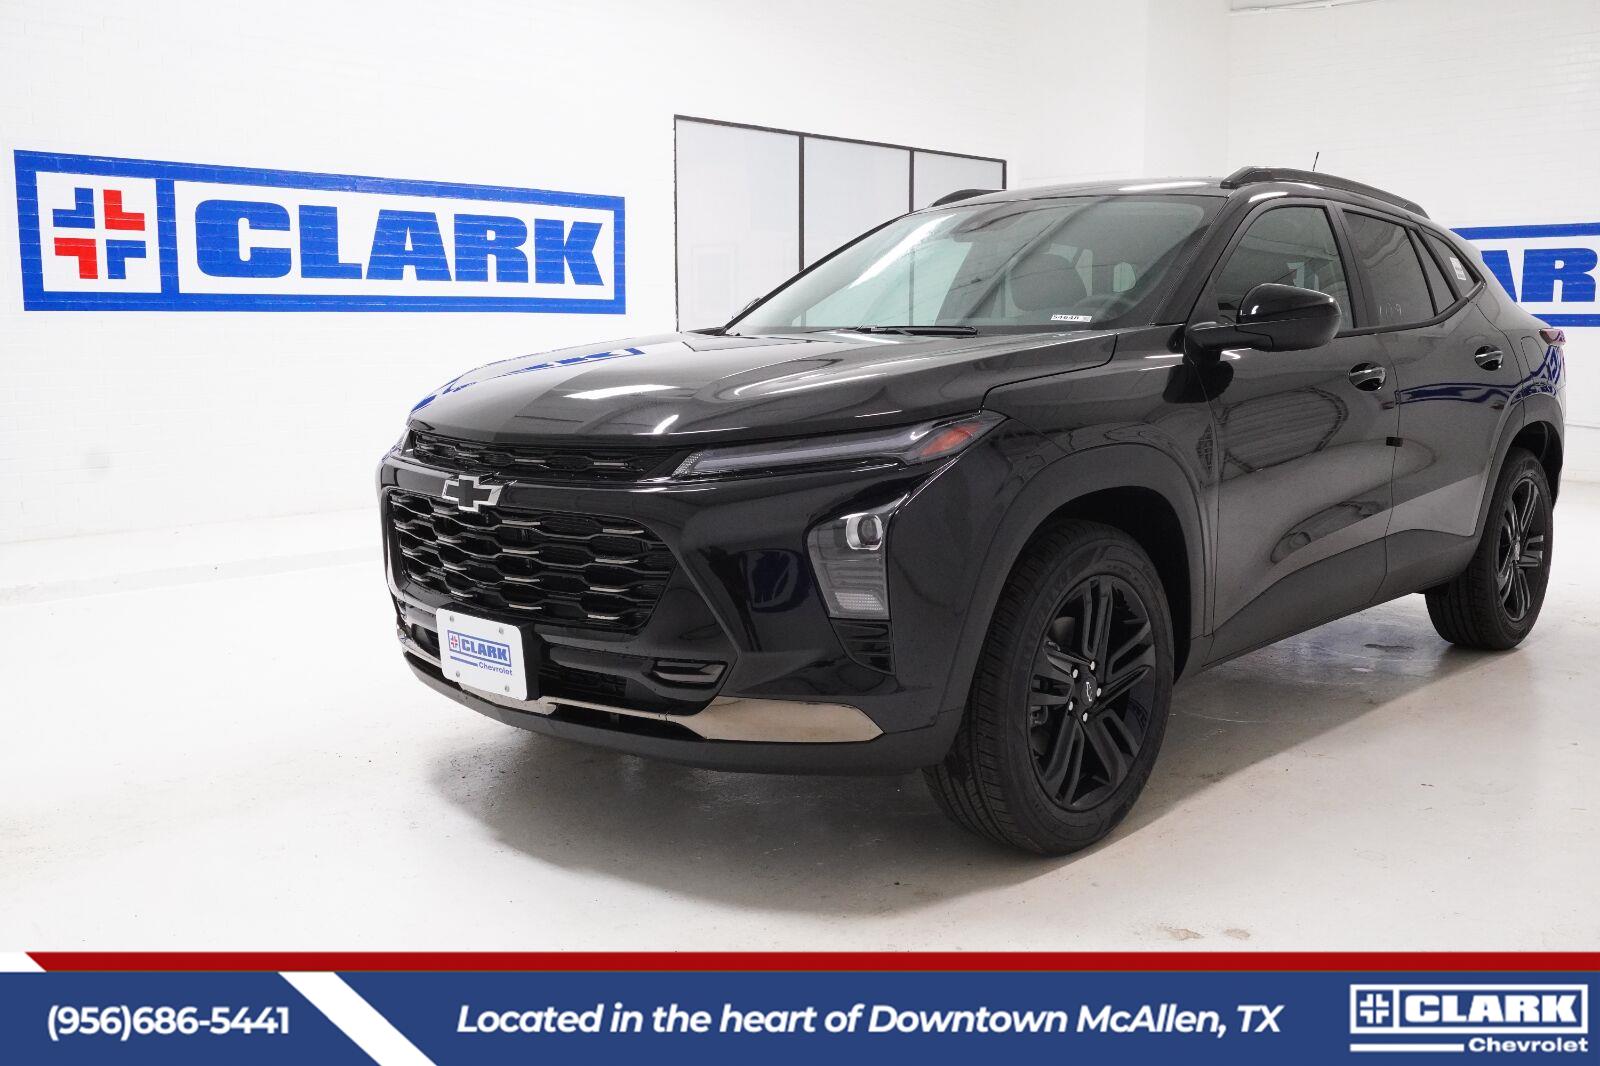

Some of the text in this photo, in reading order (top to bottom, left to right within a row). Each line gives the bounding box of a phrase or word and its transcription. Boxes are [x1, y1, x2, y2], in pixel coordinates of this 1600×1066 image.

[195, 199, 604, 287] CLARK
[461, 638, 508, 661] CLARK
[478, 662, 513, 676] Chevrolet
